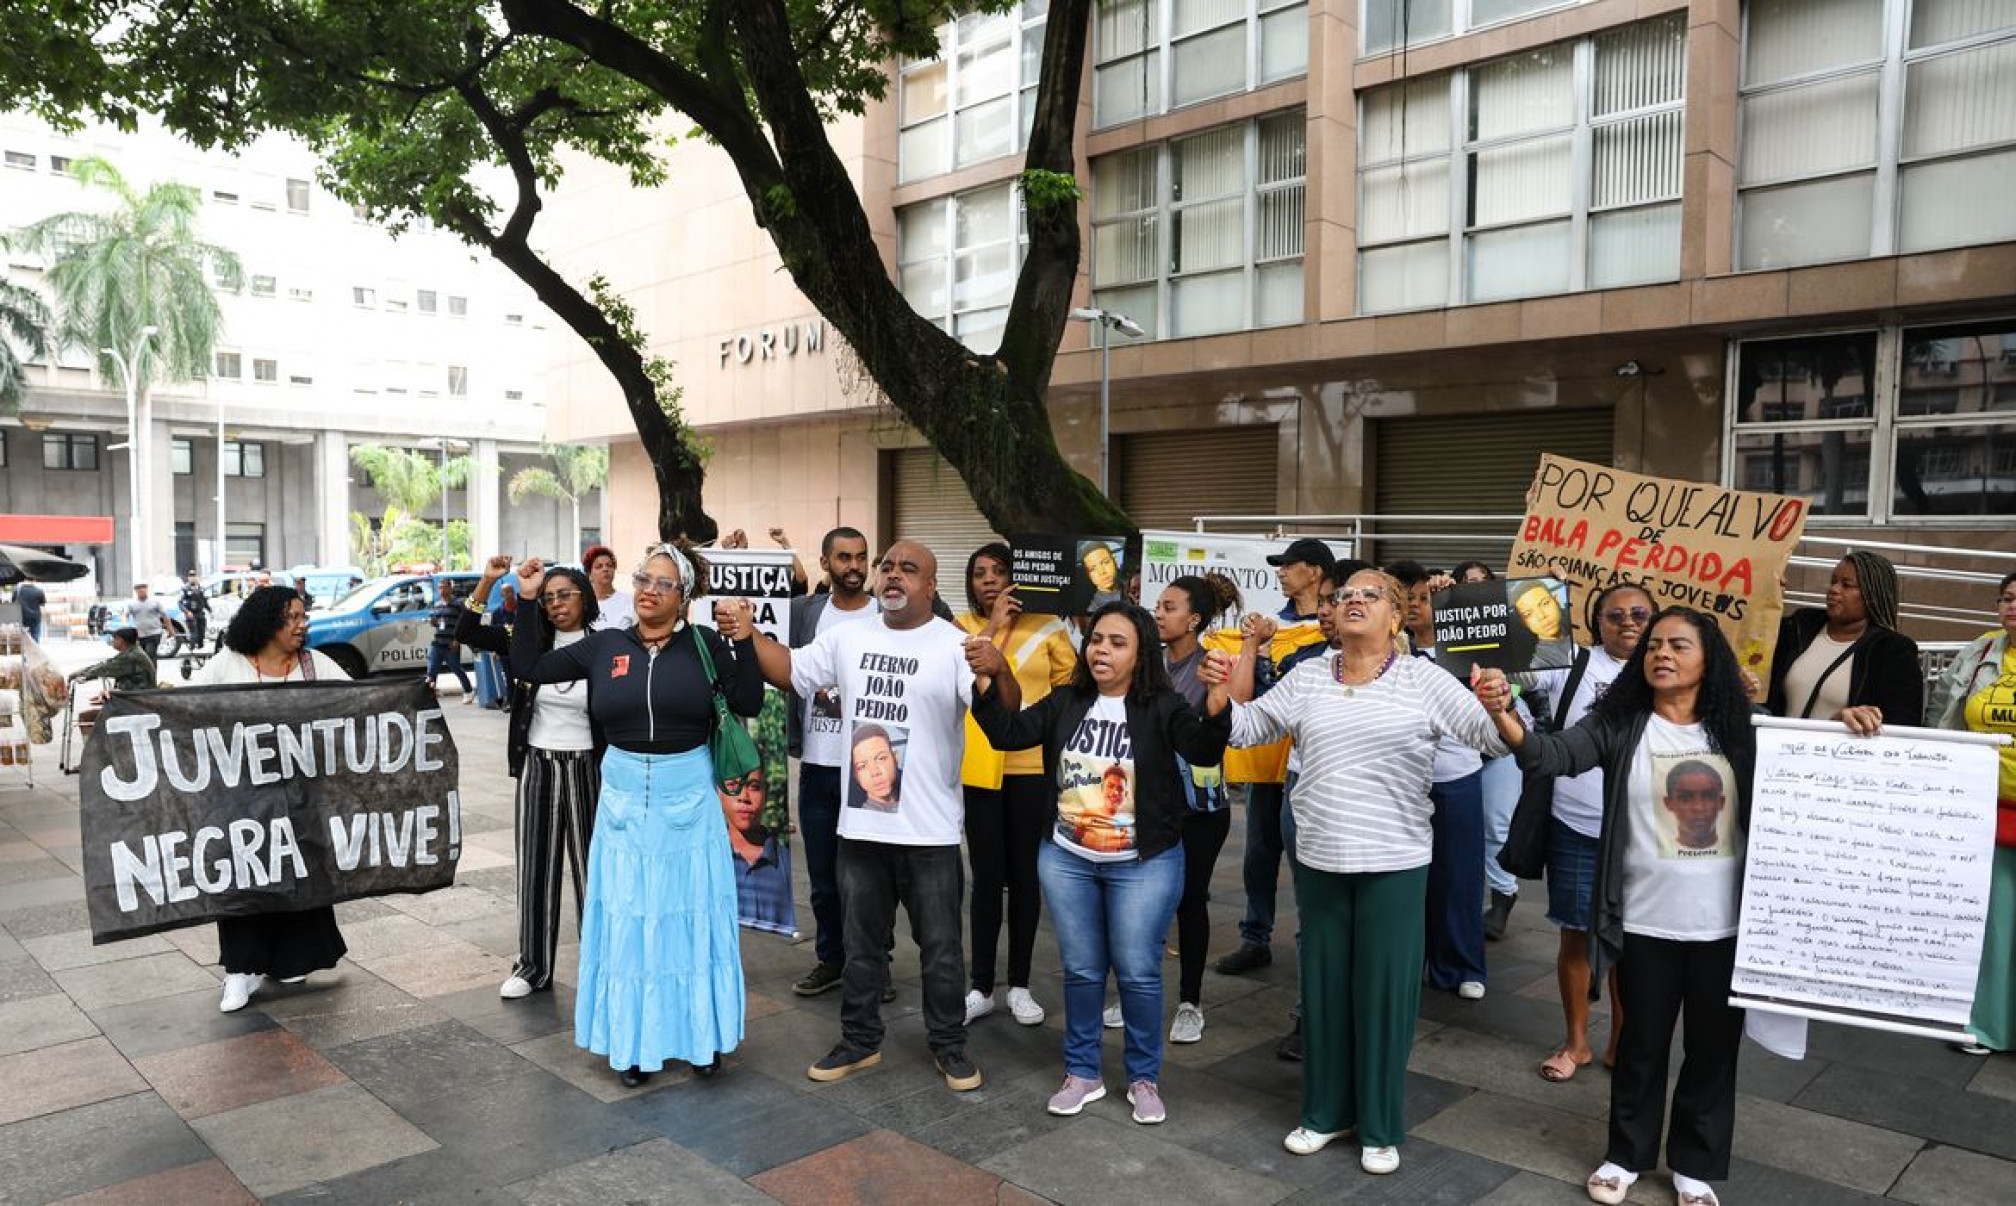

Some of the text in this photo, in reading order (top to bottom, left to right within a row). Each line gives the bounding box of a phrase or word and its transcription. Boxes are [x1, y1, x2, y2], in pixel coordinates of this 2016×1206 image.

[718, 320, 825, 369] FORUM
[1537, 462, 1615, 512] POR
[1638, 526, 1666, 544] DE
[1012, 560, 1056, 573] JOÃO PEDRO
[1516, 549, 1546, 569] SÃO
[1524, 514, 1754, 596] BALA PERDIDA
[708, 564, 790, 597] USTIÇA
[1434, 604, 1507, 623] JUSTIÇA POR
[1436, 623, 1507, 642] JOÃO PEDRO
[859, 652, 920, 676] ETERNO
[864, 675, 905, 699] JOÃO
[854, 698, 910, 723] PEDRO
[100, 709, 443, 802] JUVENTUDE
[110, 790, 460, 912] NEGRA VIVE!
